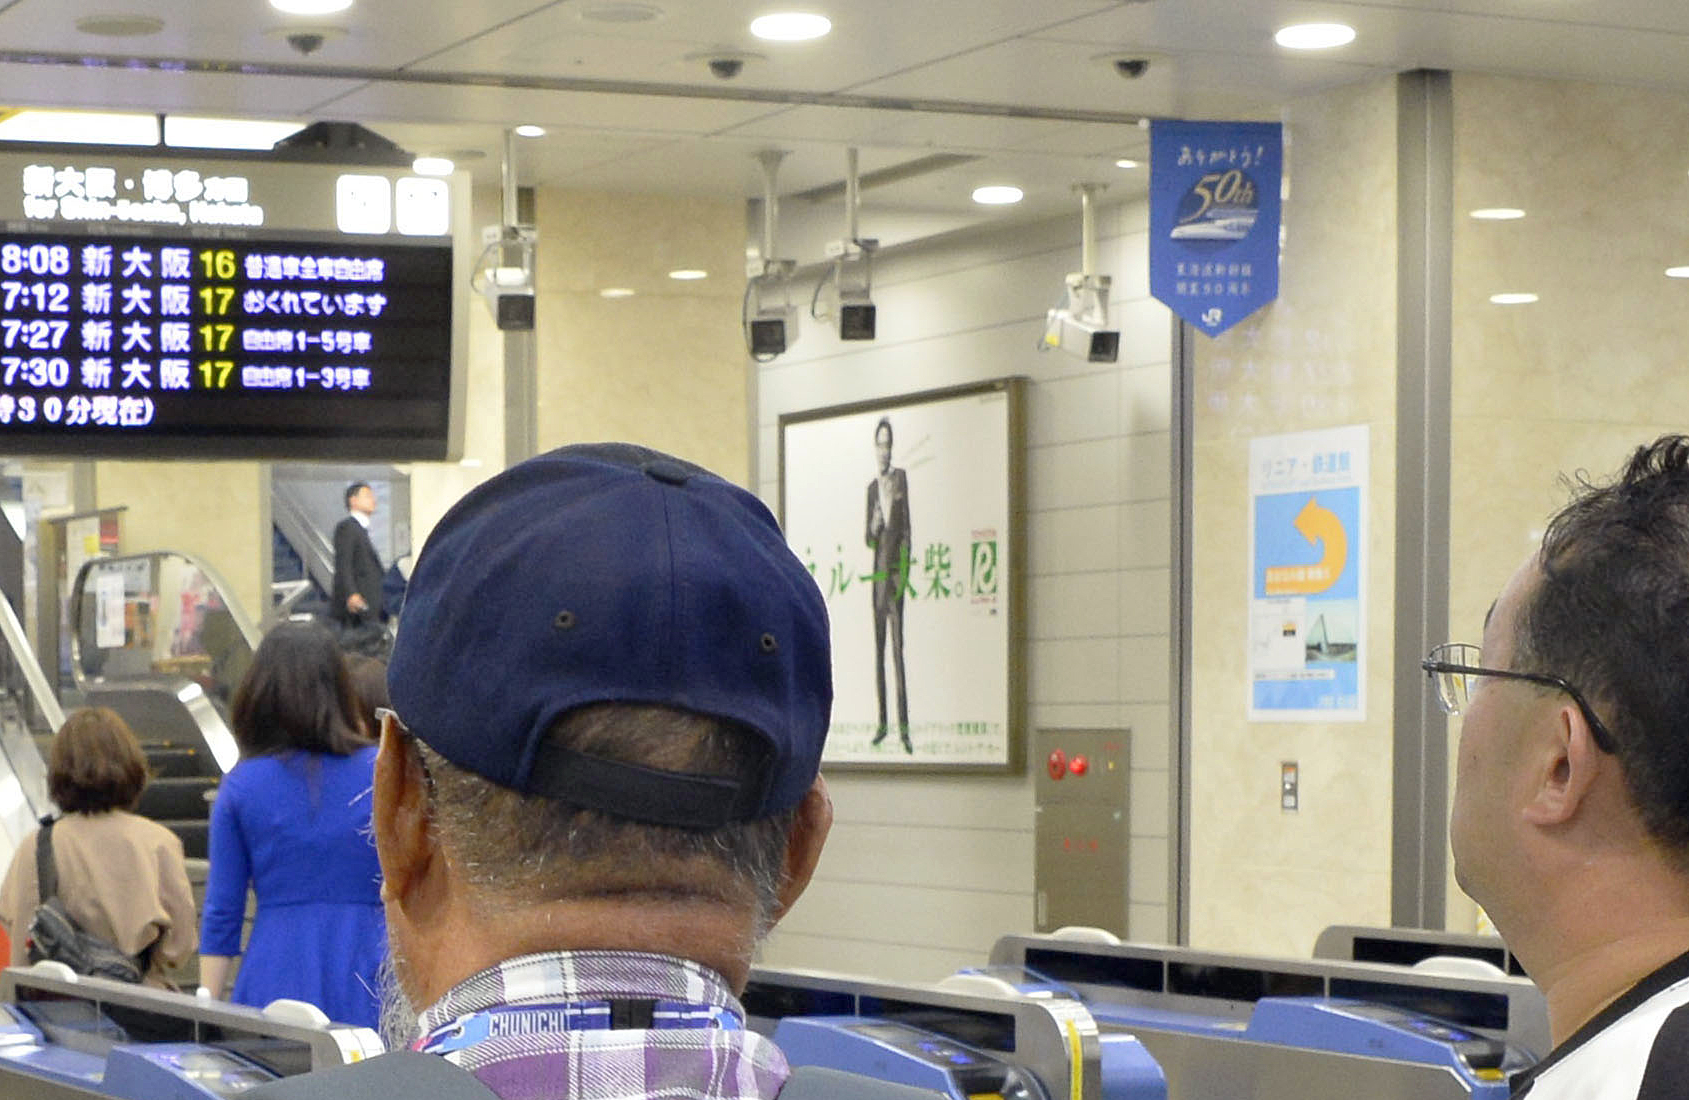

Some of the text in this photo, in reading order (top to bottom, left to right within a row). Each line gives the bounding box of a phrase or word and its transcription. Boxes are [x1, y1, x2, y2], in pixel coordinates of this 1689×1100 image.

[1, 243, 69, 275] 8:08
[81, 244, 191, 279] 新大阪
[199, 250, 236, 279] 16
[1, 281, 69, 313] 7:12
[81, 281, 191, 315] 新大阪
[199, 287, 235, 316] 17
[243, 289, 387, 317] おくれています
[1201, 308, 1222, 323] JR
[0, 319, 69, 350] 7:27
[80, 318, 191, 353] 新大阪
[199, 324, 234, 352] 17
[0, 356, 69, 388] 7:30
[80, 356, 191, 389] 新大阪
[198, 361, 233, 388] 17
[489, 1010, 566, 1037] CHUNICHI
